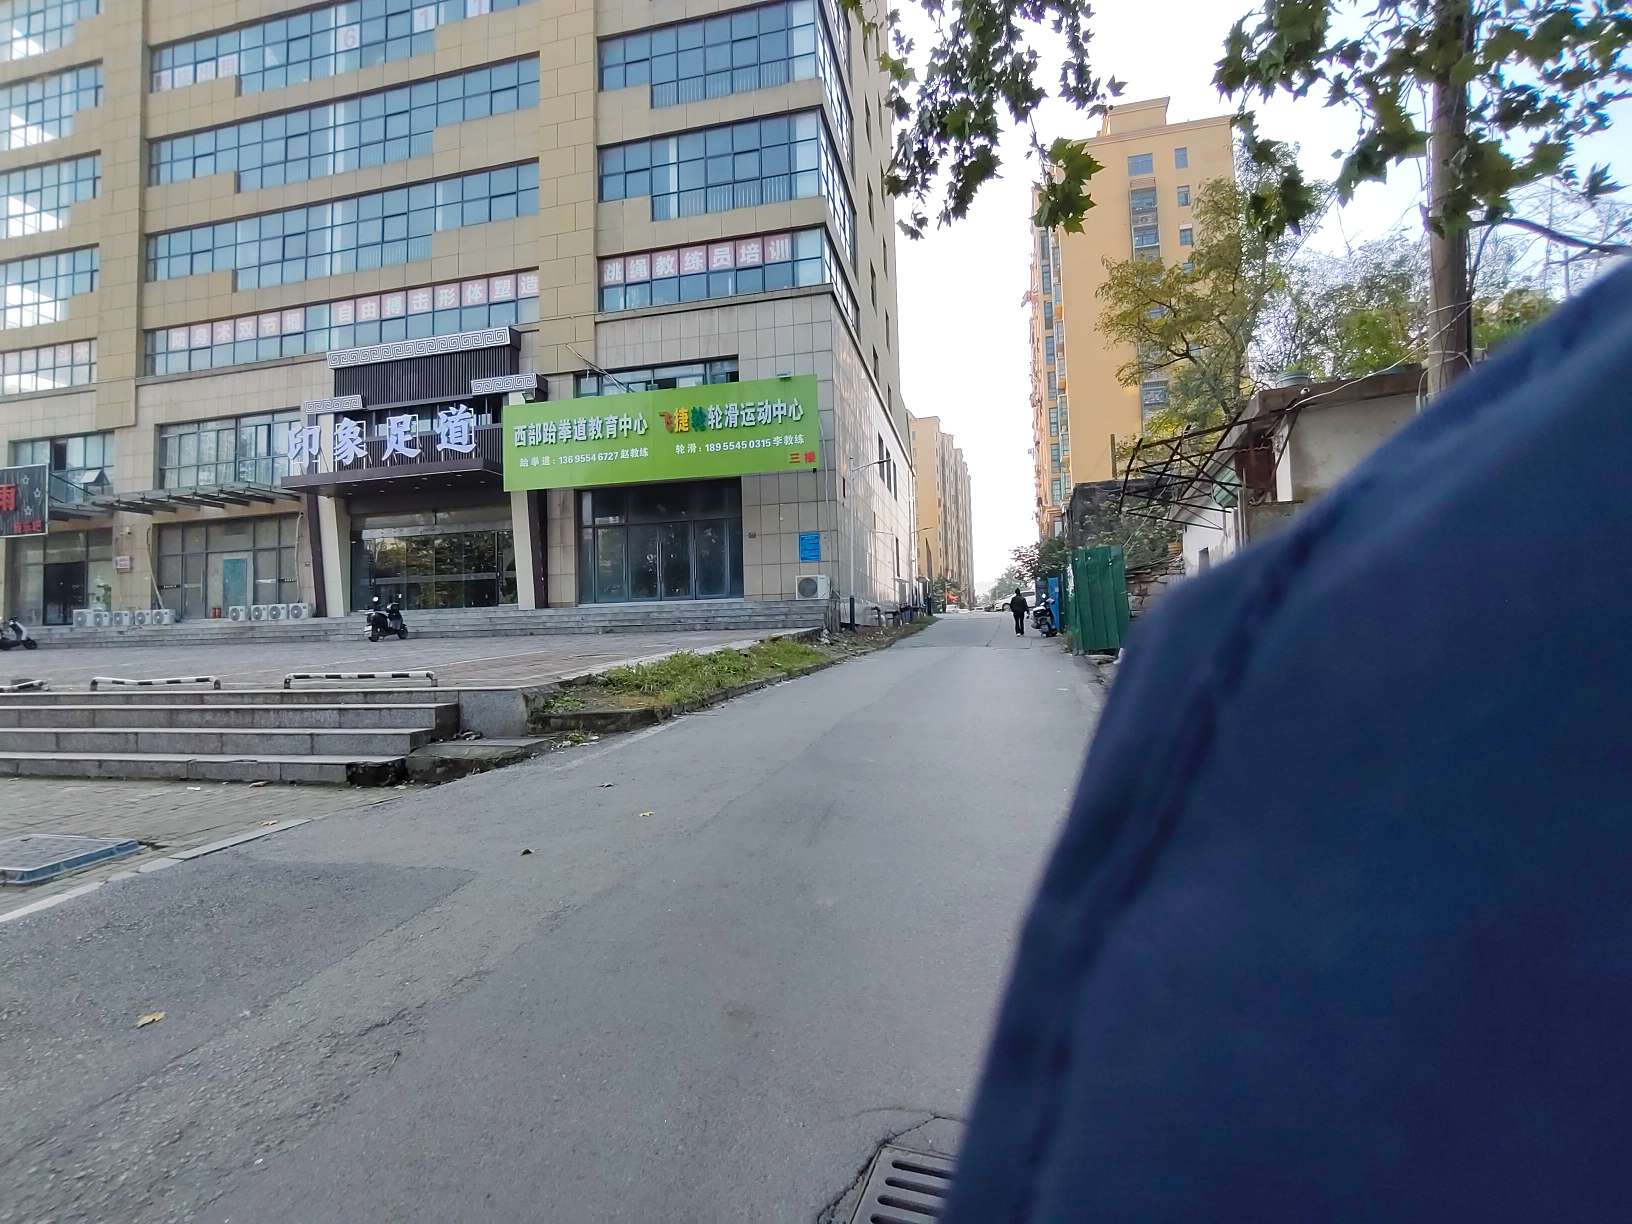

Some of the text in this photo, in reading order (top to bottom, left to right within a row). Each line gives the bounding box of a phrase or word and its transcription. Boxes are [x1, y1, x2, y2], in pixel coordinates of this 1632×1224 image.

[604, 238, 792, 283] 跳绳教练员培训
[288, 404, 476, 468] 印象足道
[514, 412, 649, 447] 西部跆拳道教育中心
